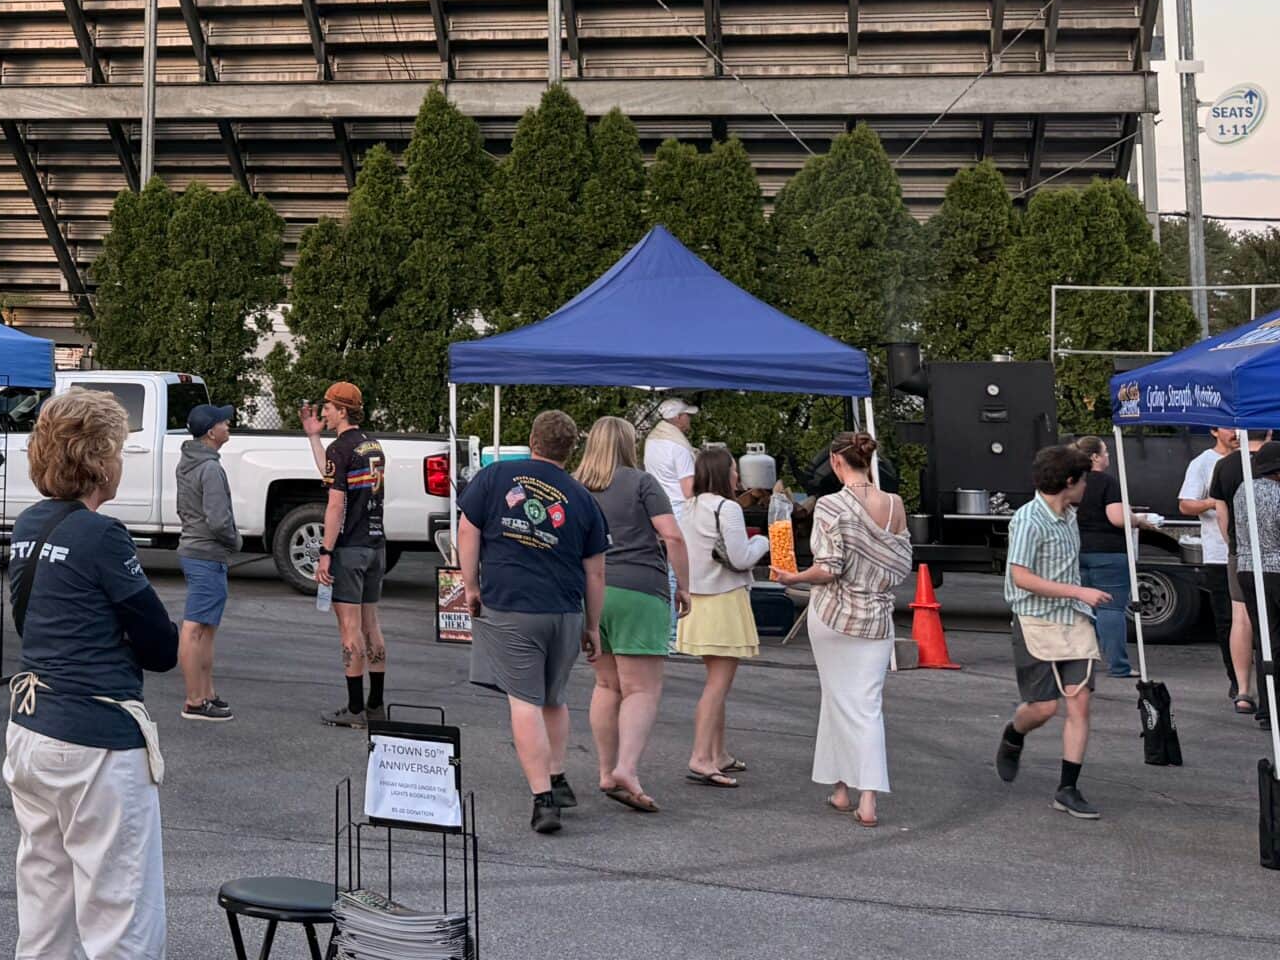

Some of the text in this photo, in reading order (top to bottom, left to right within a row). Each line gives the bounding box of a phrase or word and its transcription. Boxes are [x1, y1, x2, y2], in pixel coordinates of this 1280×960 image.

[1212, 107, 1253, 118] SEATS
[1218, 125, 1249, 135] 1-11
[1147, 383, 1166, 413] Cycling
[1167, 381, 1193, 413] Strength
[1194, 384, 1221, 407] Nutrition
[441, 613, 470, 621] ORDER
[445, 621, 466, 629] HERE
[383, 744, 422, 757] T-TOWN
[378, 759, 449, 777] ANNIVERSARY
